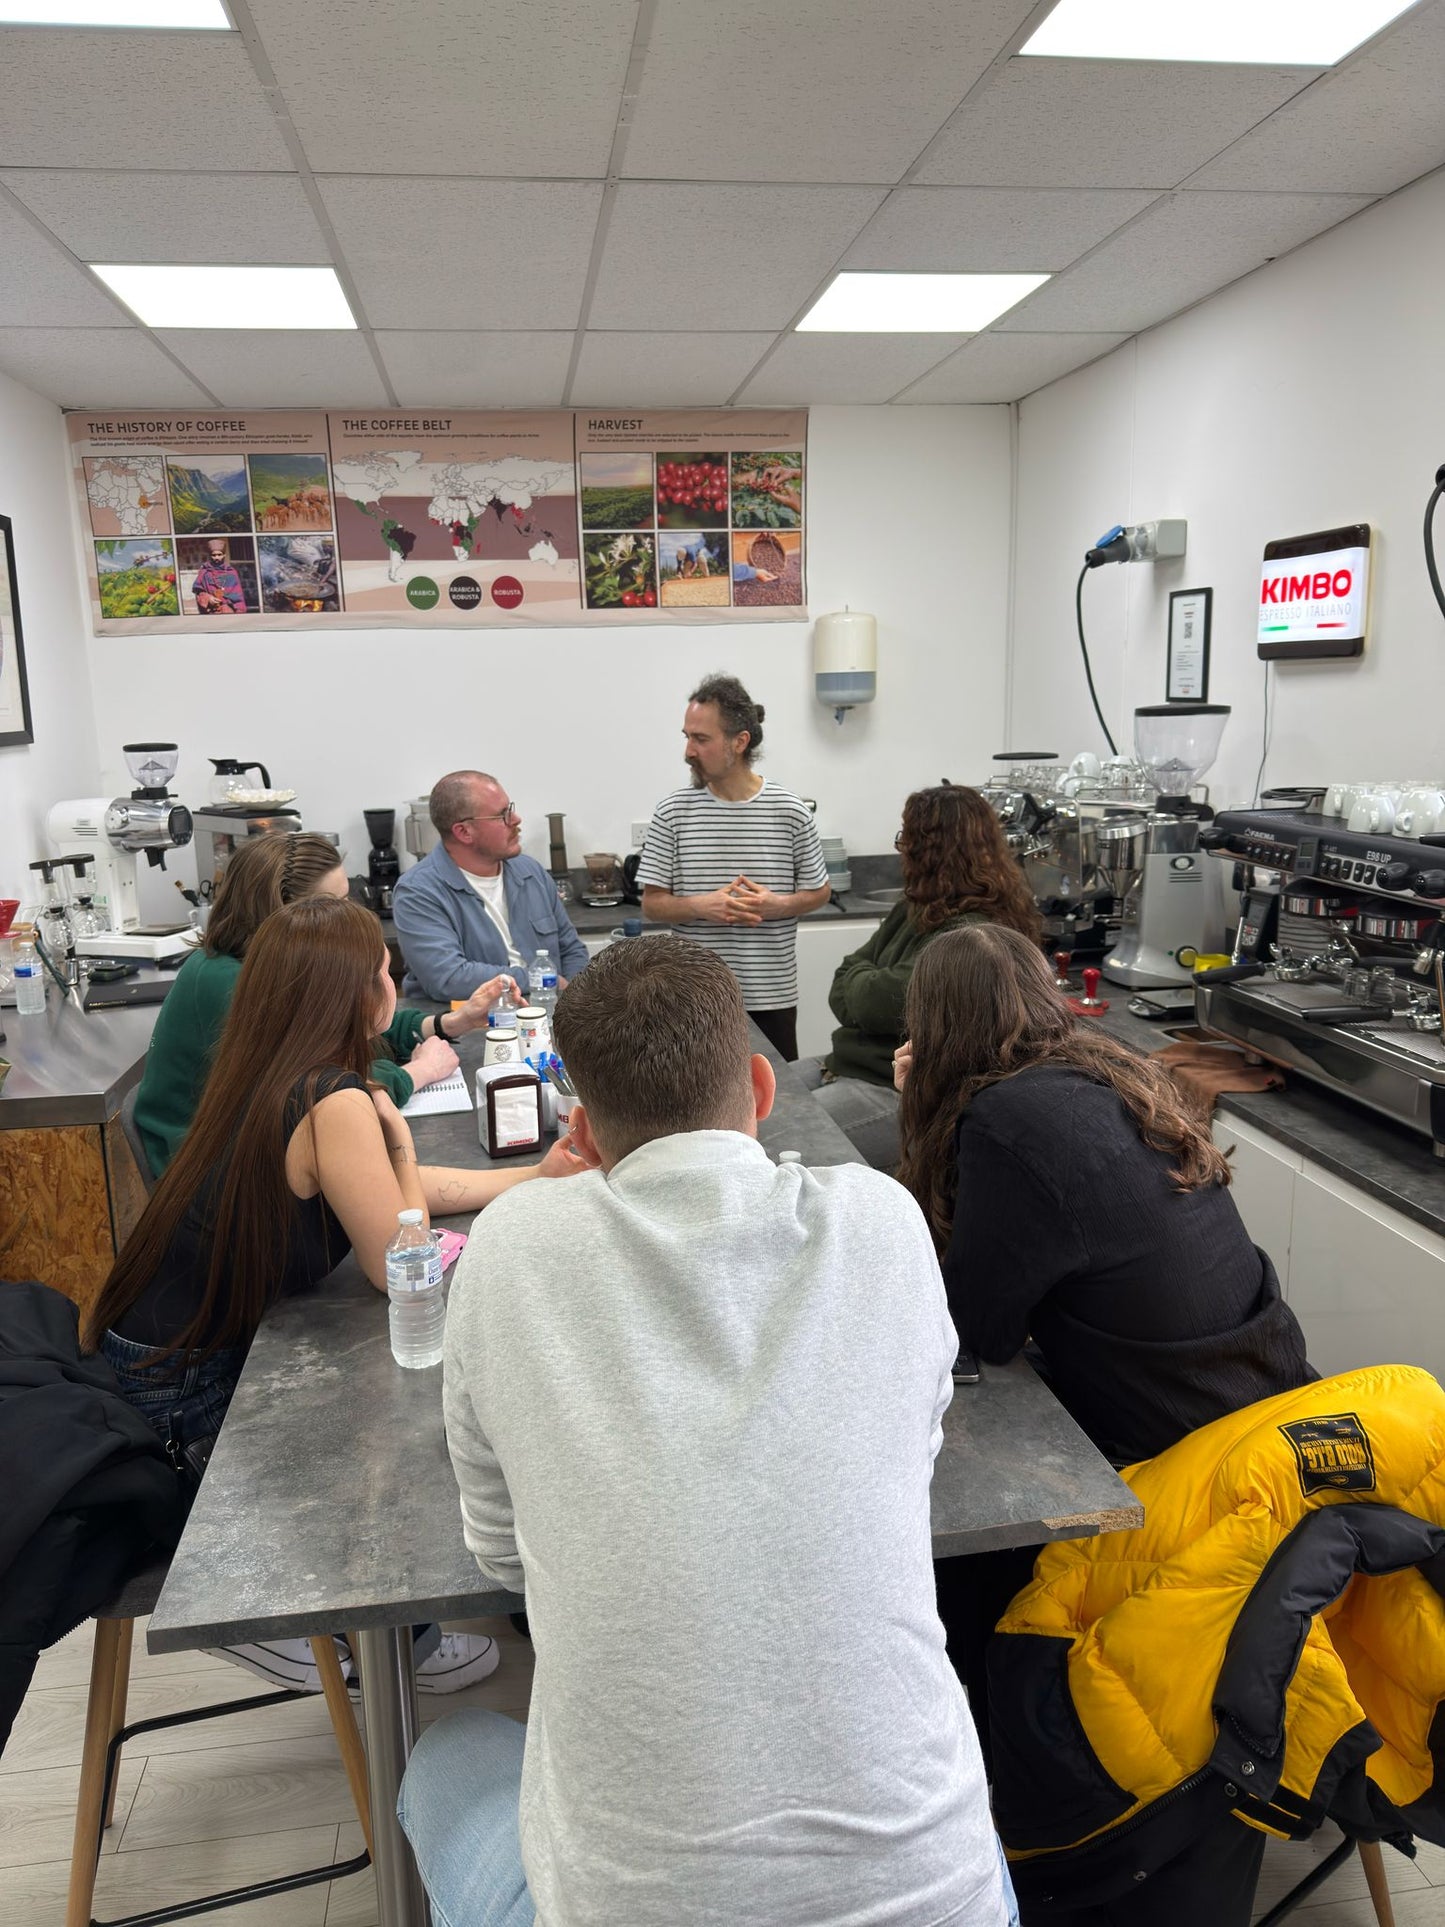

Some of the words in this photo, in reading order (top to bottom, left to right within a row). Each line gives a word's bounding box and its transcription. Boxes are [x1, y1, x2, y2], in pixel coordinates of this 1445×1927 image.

[87, 422, 114, 433] THE
[116, 421, 172, 433] HISTORY
[175, 420, 193, 432] OF
[196, 420, 247, 432] COFFEE
[342, 419, 368, 430] THE
[371, 419, 420, 430] COFFEE
[422, 419, 452, 430] BELT
[587, 419, 643, 430] HARVEST
[1261, 569, 1352, 604] KIMBO
[1259, 606, 1302, 622] ESPRESSO
[1305, 602, 1352, 618] ITALIANO
[1380, 853, 1392, 864] UP
